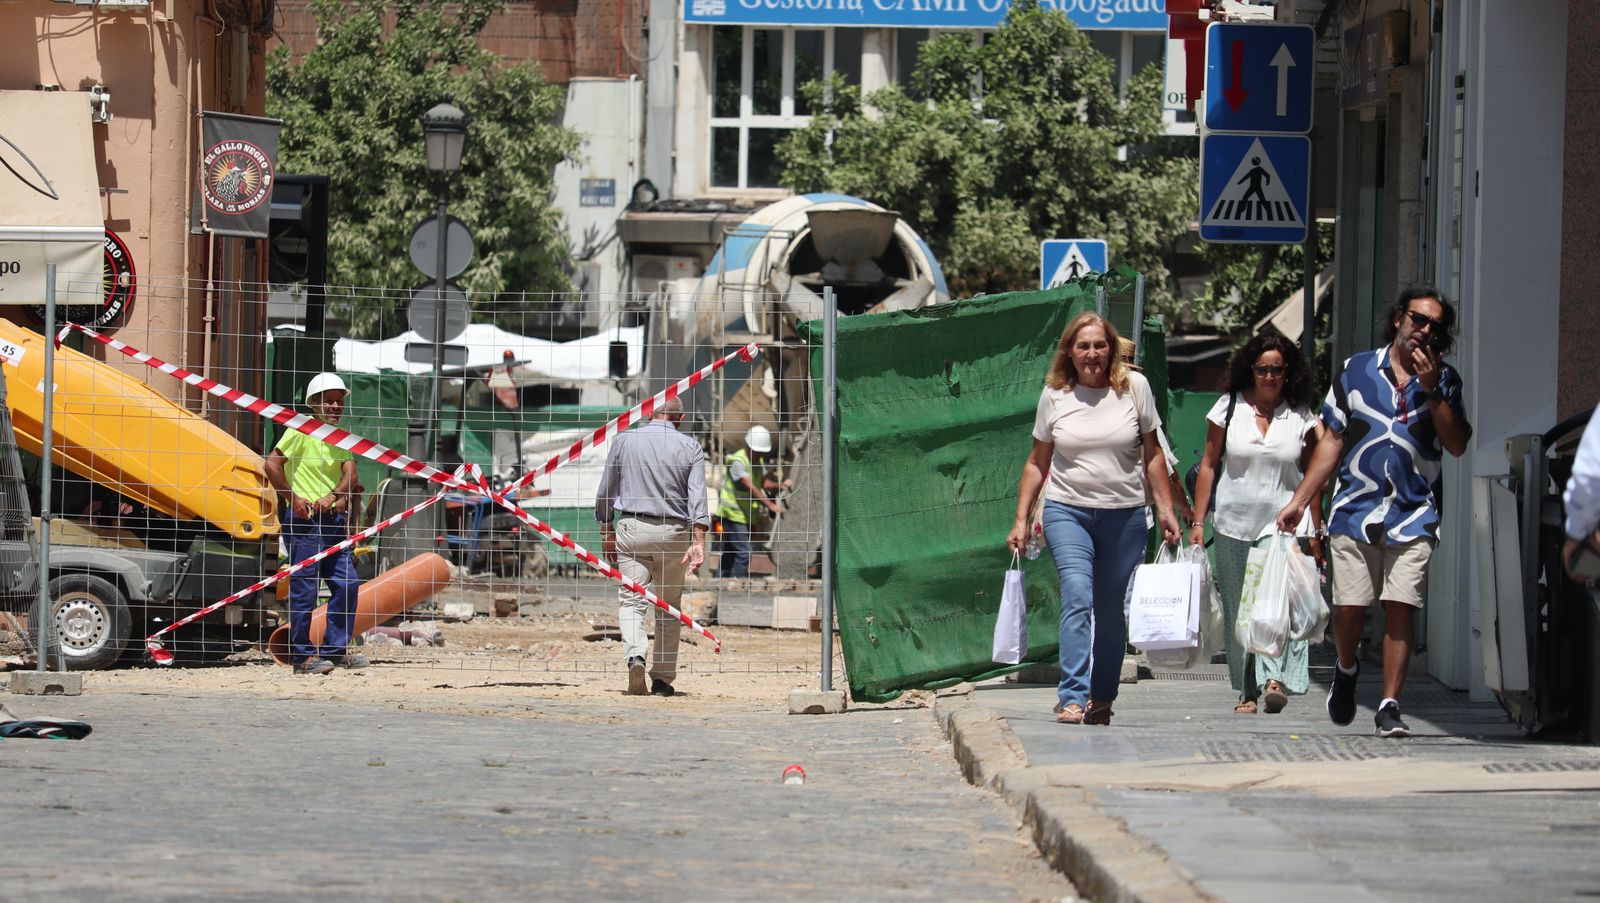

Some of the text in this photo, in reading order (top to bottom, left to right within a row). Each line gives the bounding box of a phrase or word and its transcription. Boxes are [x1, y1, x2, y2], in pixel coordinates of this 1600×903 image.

[872, 0, 1012, 11] CAMO
[204, 143, 268, 169] EL GALLO NEGRO
[238, 188, 265, 212] MONJAS
[0, 261, 20, 276] po
[2, 344, 16, 356] 45
